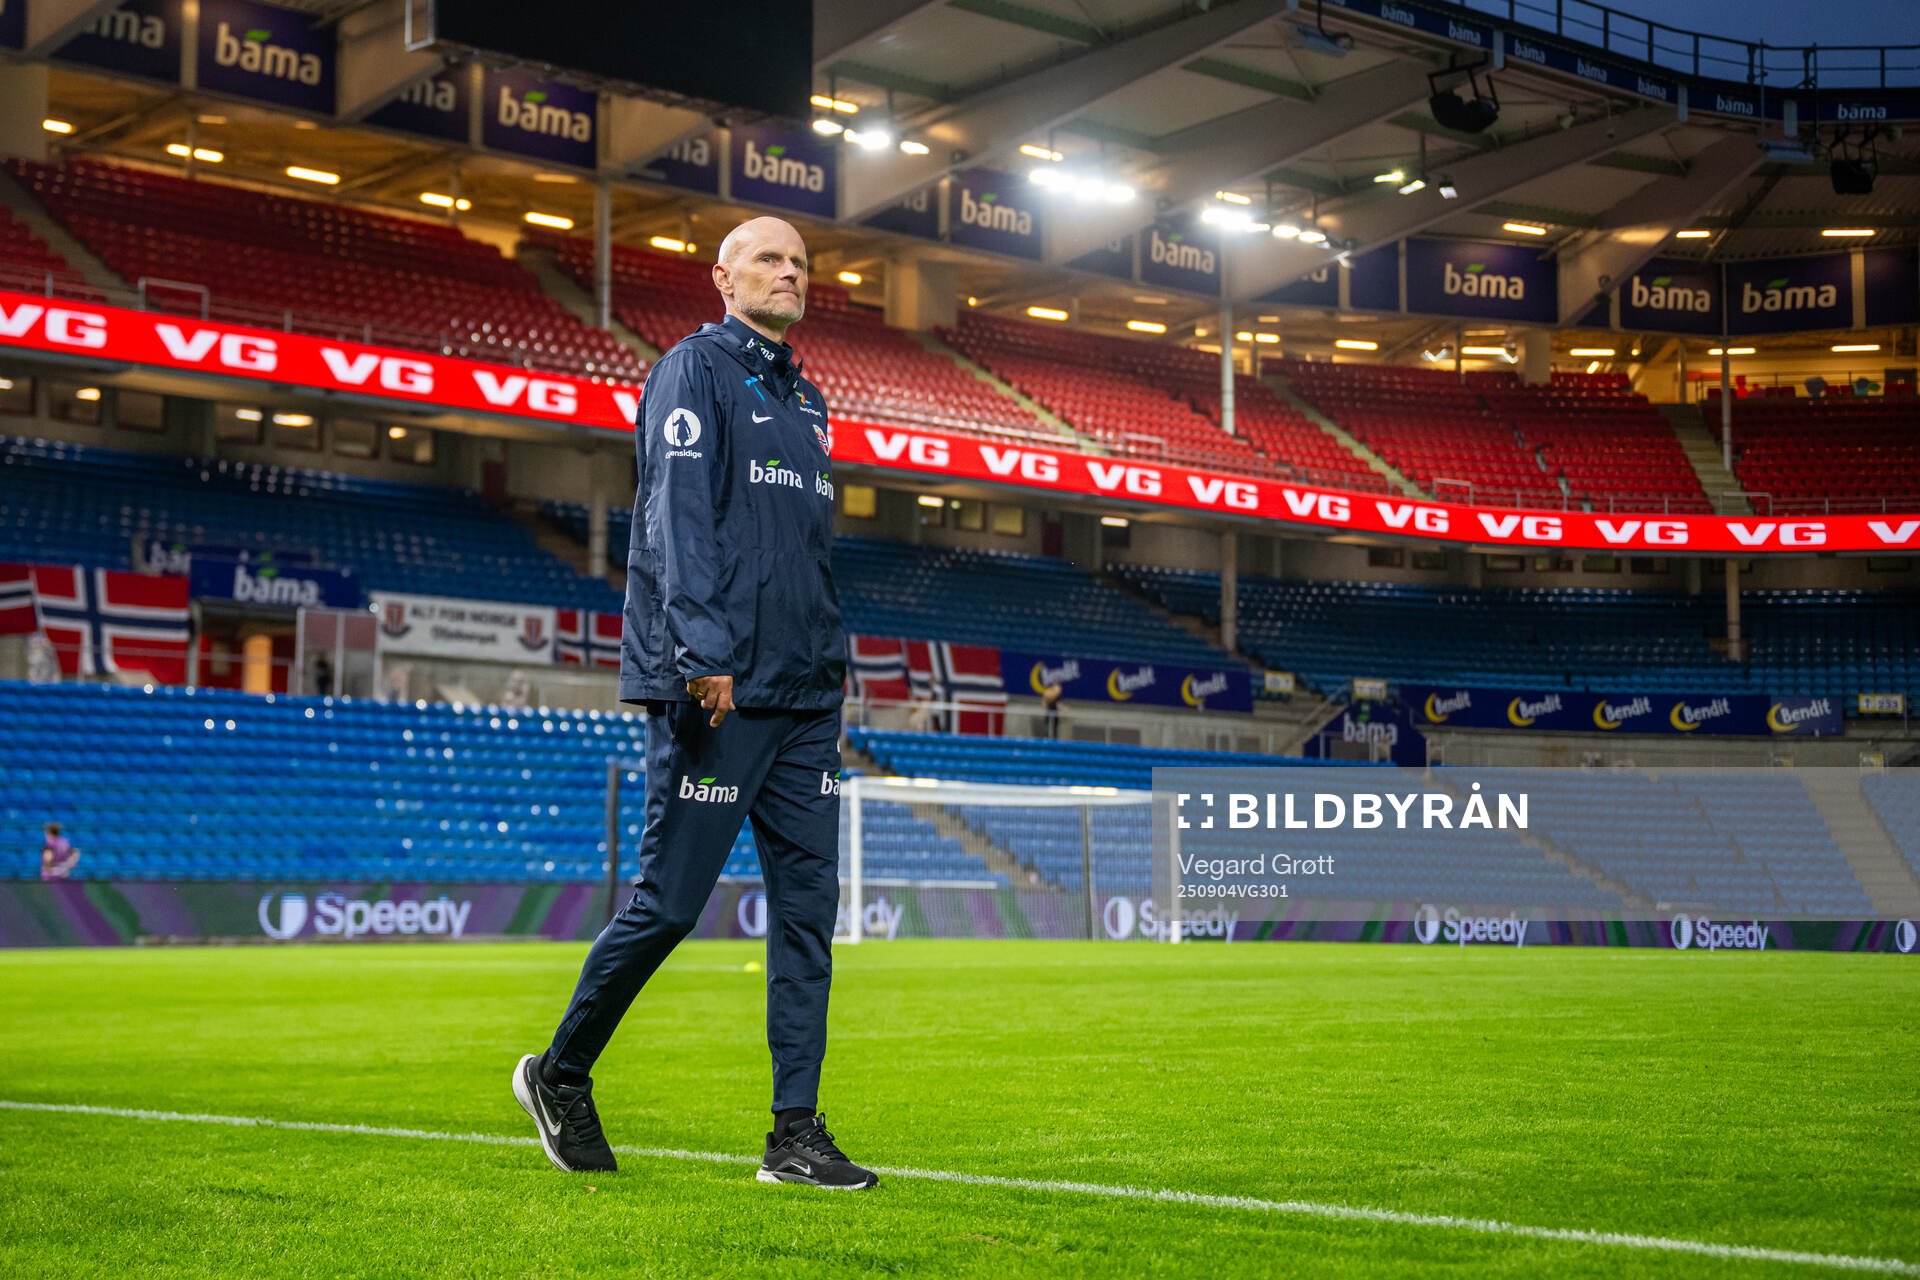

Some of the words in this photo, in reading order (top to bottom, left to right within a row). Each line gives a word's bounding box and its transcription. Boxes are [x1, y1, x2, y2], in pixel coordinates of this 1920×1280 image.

[156, 323, 278, 371] VG
[320, 347, 434, 394] VG
[472, 370, 578, 415] VG
[864, 428, 950, 468] VG
[979, 444, 1060, 482] VG
[1086, 461, 1162, 497] VG
[1187, 476, 1259, 509] VG
[1283, 489, 1351, 522] VG
[1376, 501, 1450, 533] VG
[1478, 512, 1563, 540] VG
[1595, 520, 1689, 544] VG
[1726, 522, 1827, 545] VG
[1867, 520, 1920, 544] V
[1605, 695, 1652, 722] Bendit
[1683, 697, 1731, 724] Bendit
[1779, 696, 1832, 724] Bendit
[679, 775, 739, 803] bama
[313, 891, 472, 939] Speedy
[1442, 905, 1529, 948] Speedy
[1695, 915, 1769, 951] Speedy
